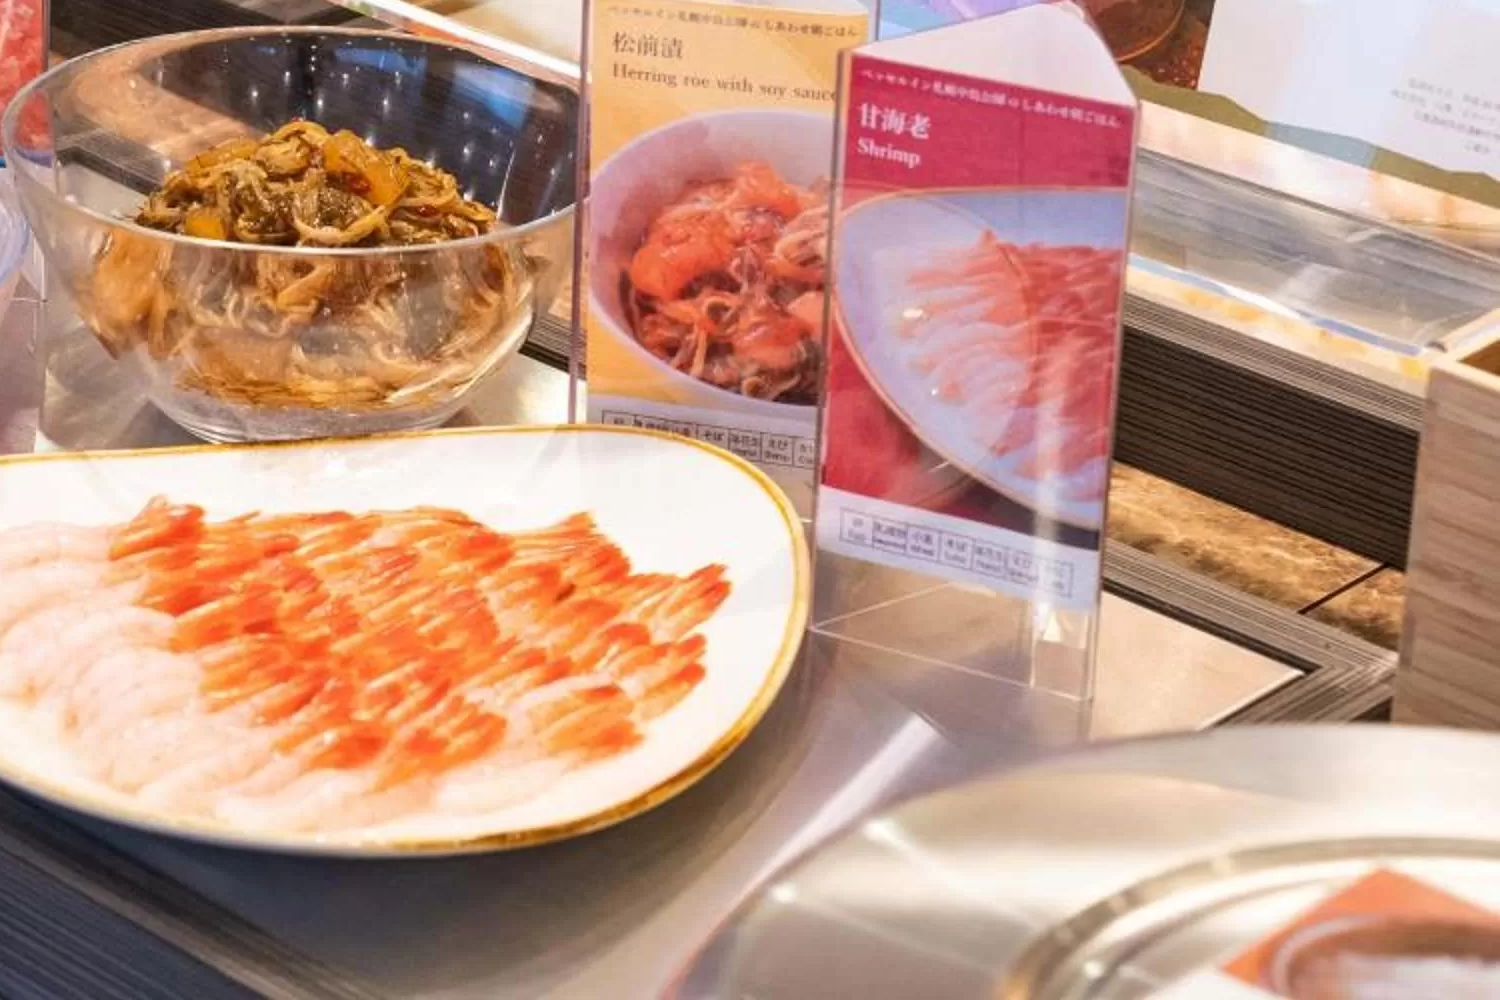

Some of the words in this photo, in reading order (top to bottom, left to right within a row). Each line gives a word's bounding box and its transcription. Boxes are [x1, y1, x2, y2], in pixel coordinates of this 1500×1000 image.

[611, 30, 684, 60] 松前漬
[612, 62, 677, 87] Herring
[684, 77, 710, 89] roe
[717, 76, 754, 94] with
[759, 85, 788, 100] soy
[857, 101, 932, 141] 甘海老
[857, 137, 921, 169] Shrimp
